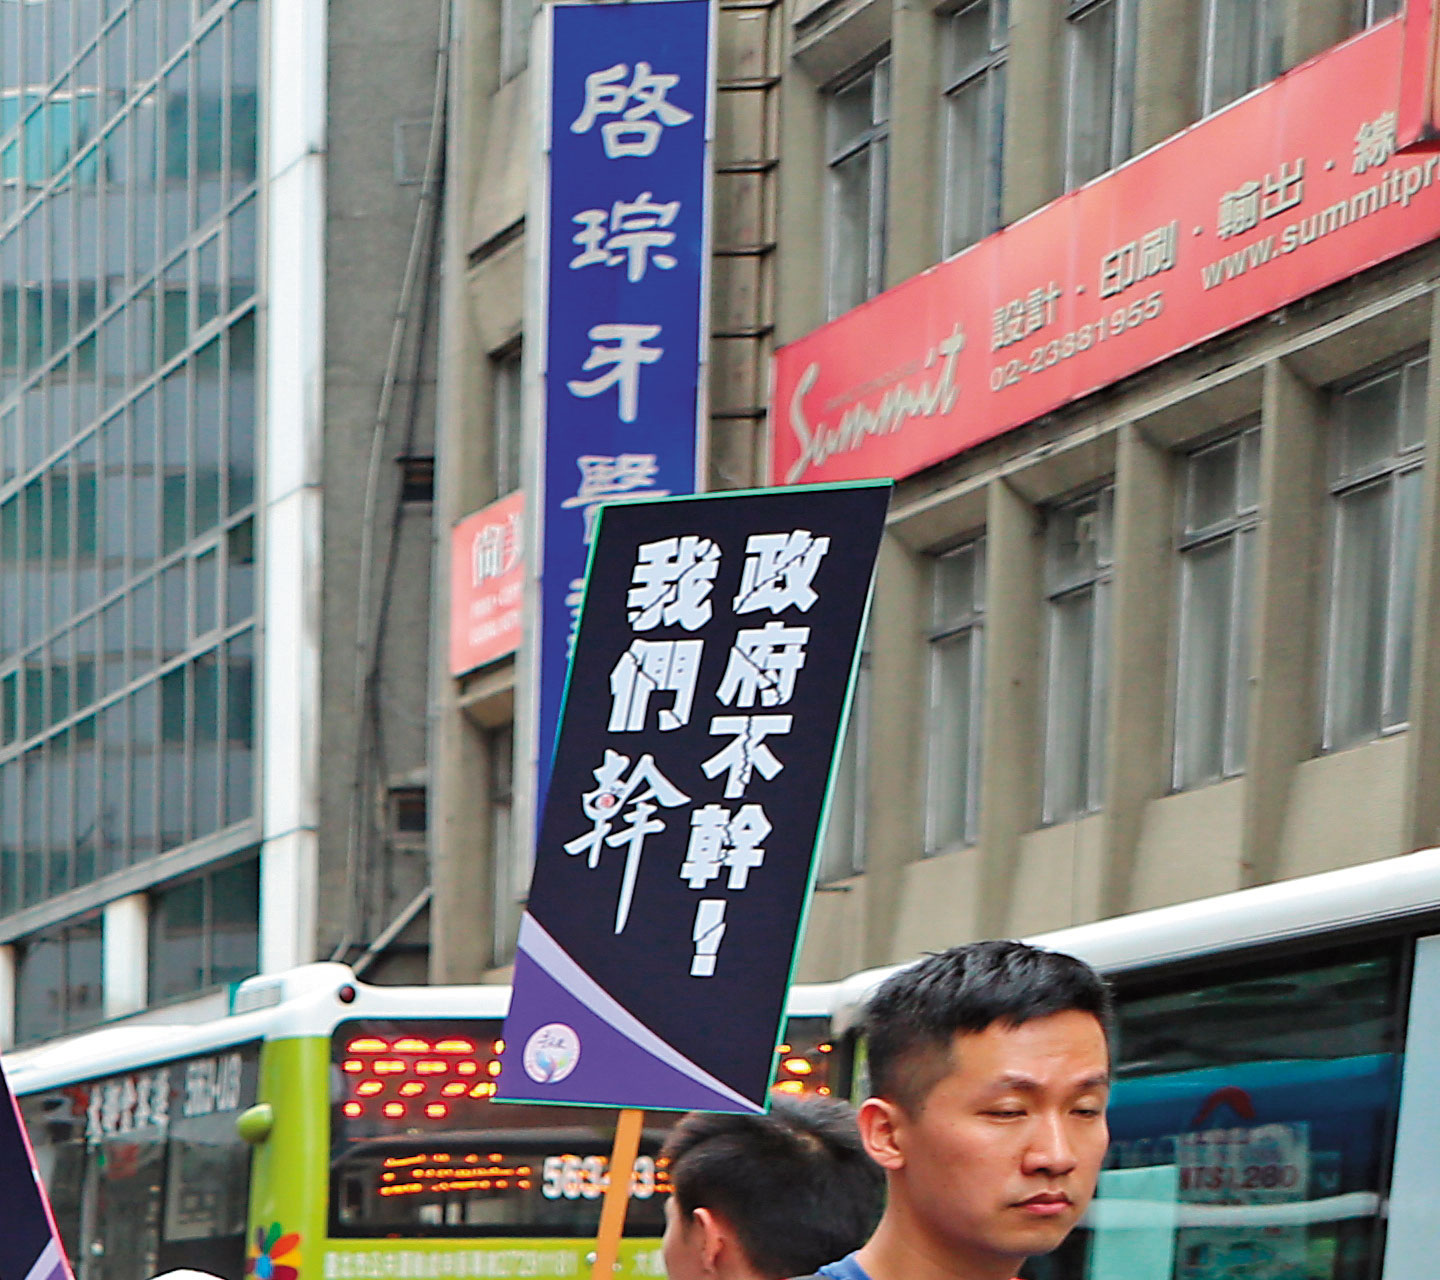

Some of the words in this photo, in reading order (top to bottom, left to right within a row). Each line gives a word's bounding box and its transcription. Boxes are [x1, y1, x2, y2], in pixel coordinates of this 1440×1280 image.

[989, 284, 1062, 354] 設計
[1099, 219, 1177, 299] 印刷
[1217, 158, 1305, 240] 輸出
[564, 534, 723, 935] 我們幹
